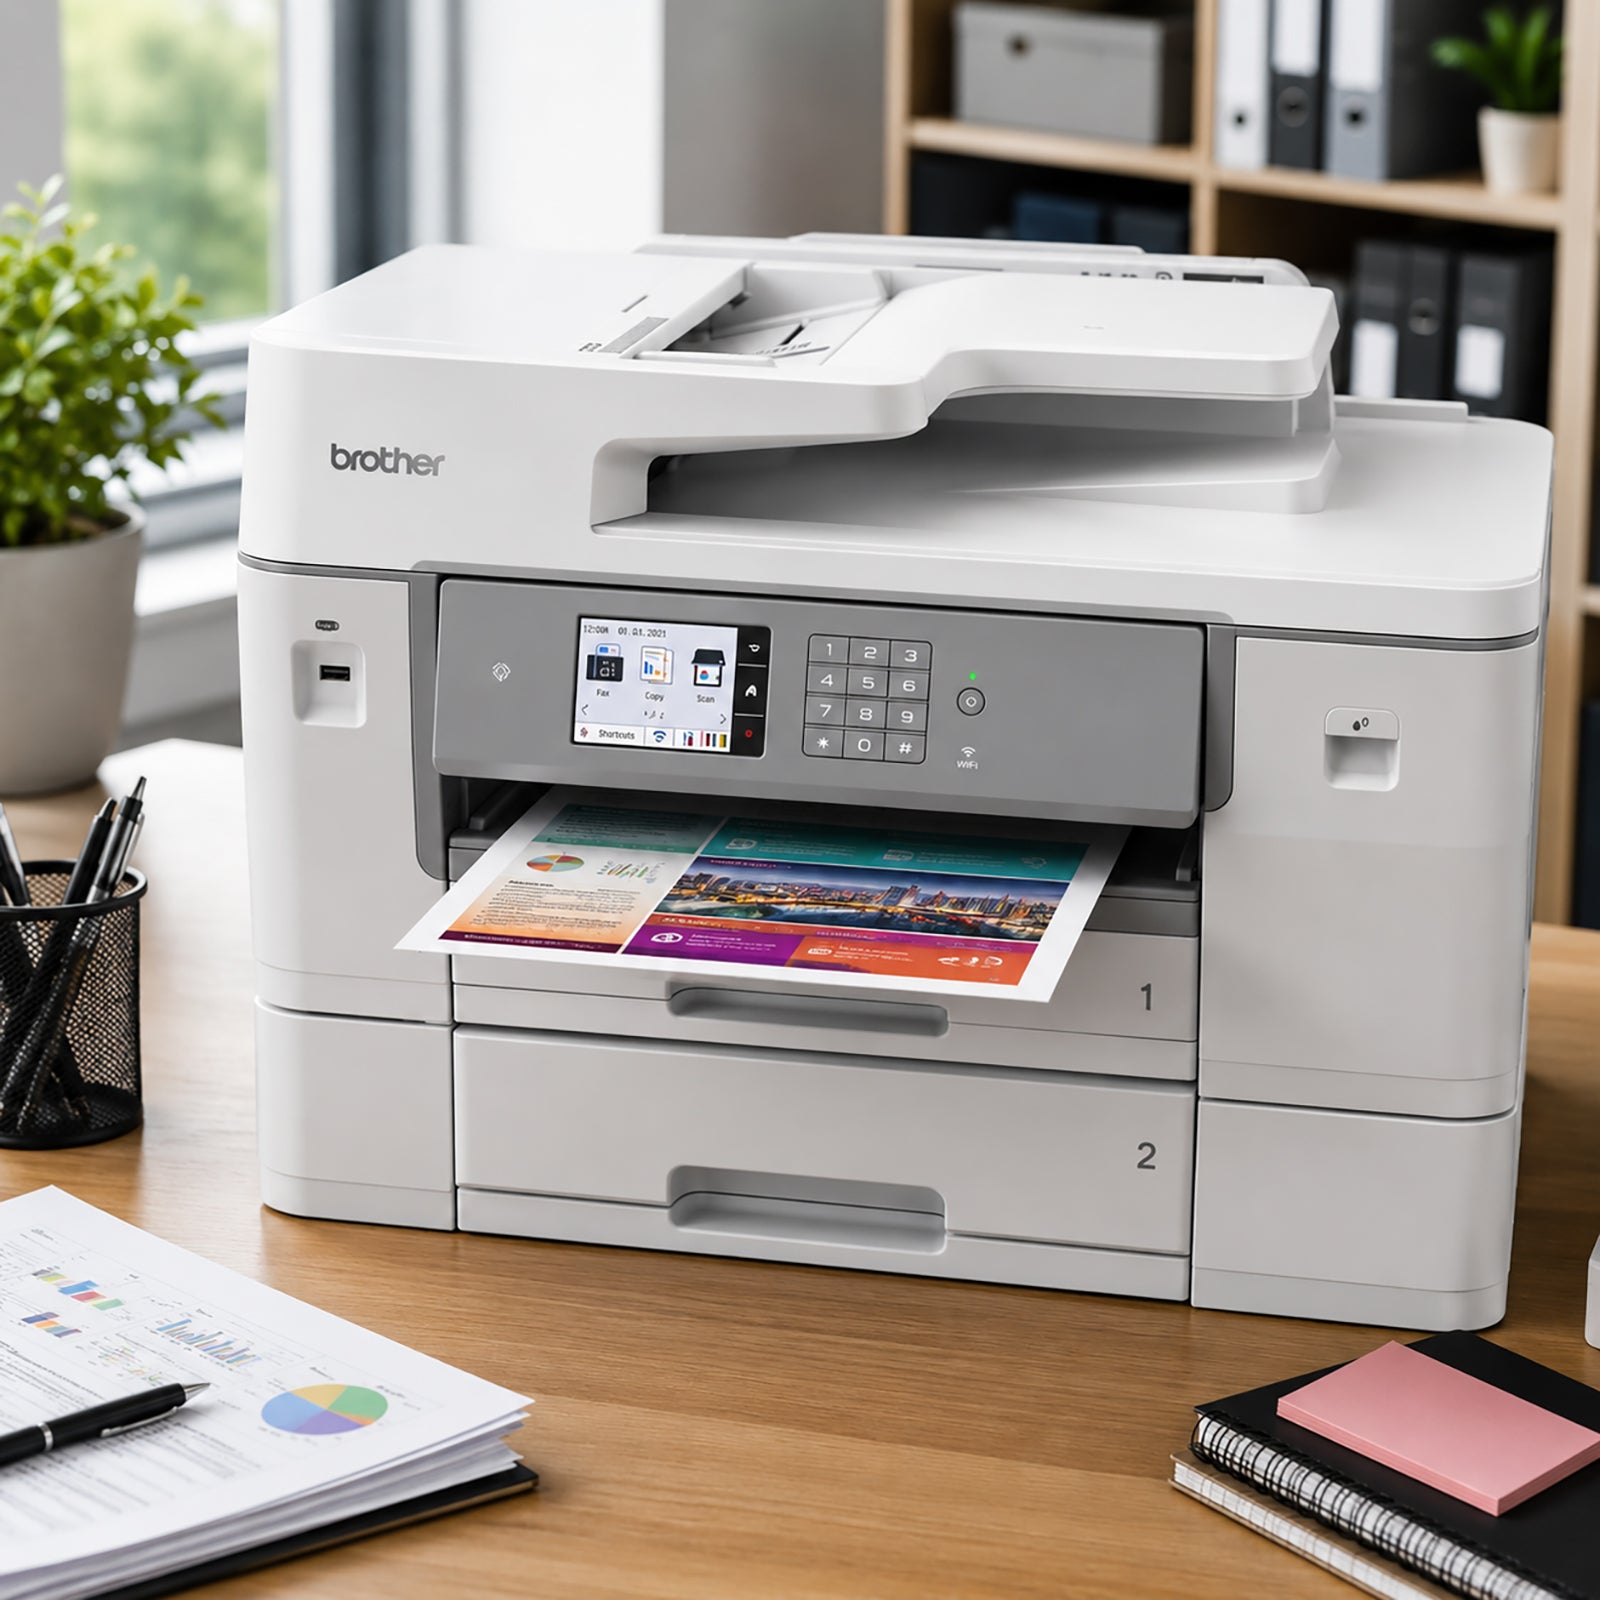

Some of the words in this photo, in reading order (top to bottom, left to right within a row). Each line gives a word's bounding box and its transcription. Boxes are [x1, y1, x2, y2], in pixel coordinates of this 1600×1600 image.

[331, 443, 446, 476] brother
[826, 643, 833, 656] 1
[864, 646, 877, 660] 2
[904, 649, 918, 663] 3
[820, 673, 834, 687] 4
[862, 676, 875, 690] 5
[903, 679, 916, 693] 6
[596, 688, 610, 697] Fax
[645, 691, 664, 702] Copy
[697, 694, 715, 704] Scan
[819, 703, 832, 718] 7
[859, 707, 873, 721] 8
[901, 710, 914, 724] 9
[598, 729, 636, 740] Shortcuts
[857, 738, 872, 752] 0
[956, 760, 978, 770] WiFi
[1140, 982, 1152, 1011] 1
[1136, 1141, 1157, 1170] 2
